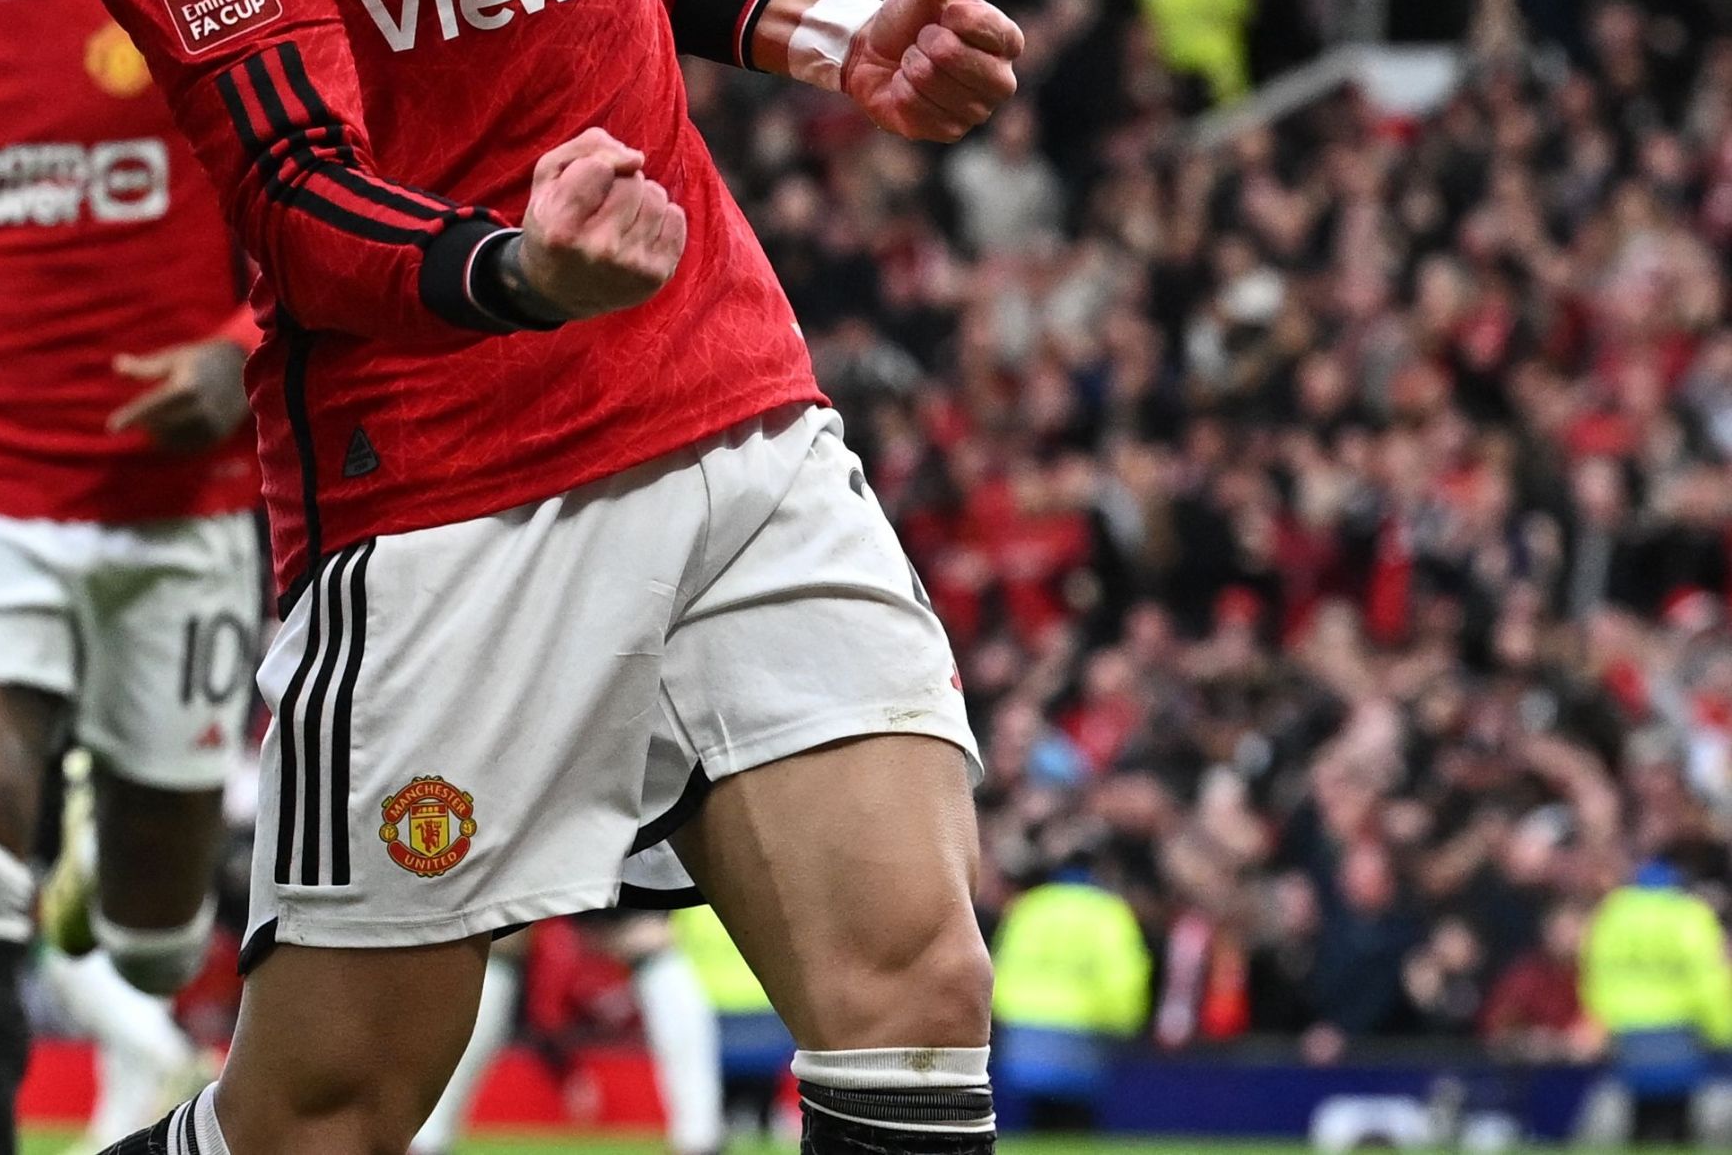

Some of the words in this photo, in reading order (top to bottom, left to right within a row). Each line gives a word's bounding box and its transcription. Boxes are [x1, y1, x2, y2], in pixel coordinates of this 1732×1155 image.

[189, 16, 221, 41] FA
[179, 611, 250, 706] 10
[390, 784, 467, 818] MANCHESTER
[404, 851, 458, 870] UNITED
